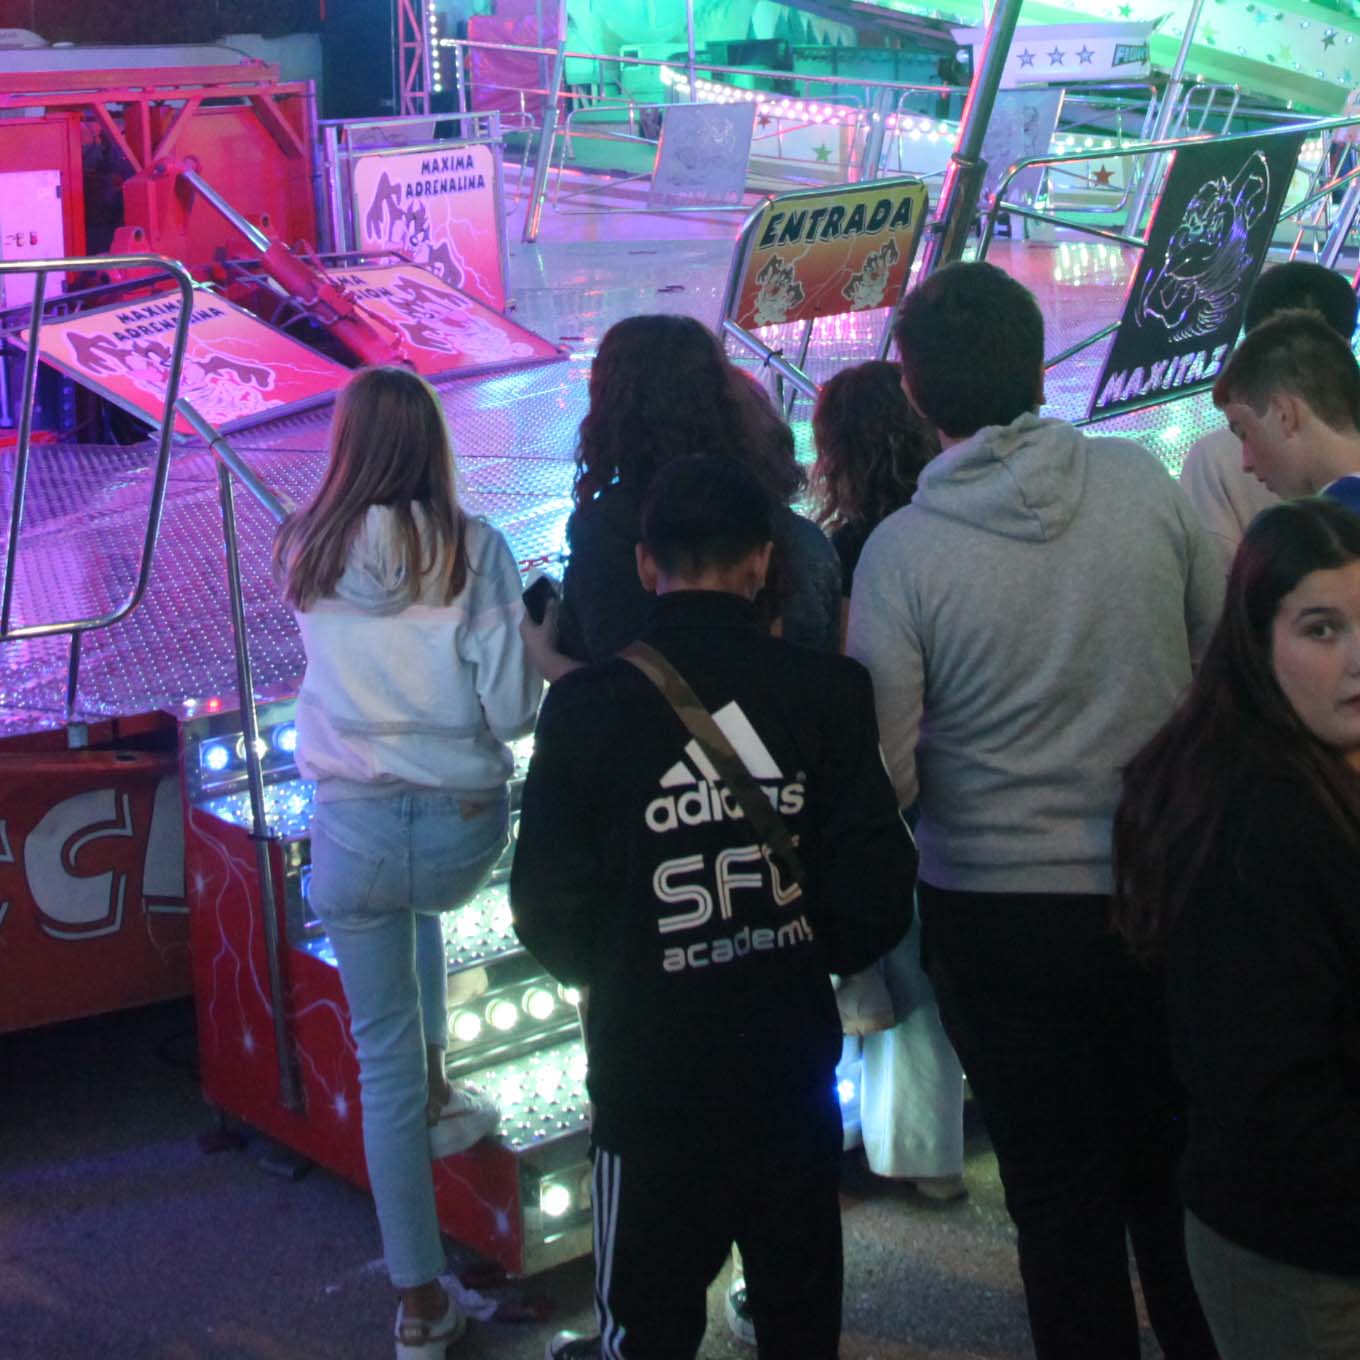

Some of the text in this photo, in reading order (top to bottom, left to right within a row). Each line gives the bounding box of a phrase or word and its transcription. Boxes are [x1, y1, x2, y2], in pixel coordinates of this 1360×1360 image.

[421, 155, 474, 175] MAXIMA
[405, 175, 485, 198] ADRENALINA
[759, 196, 914, 250] ENTRADA
[1096, 343, 1228, 407] MAXITAZ
